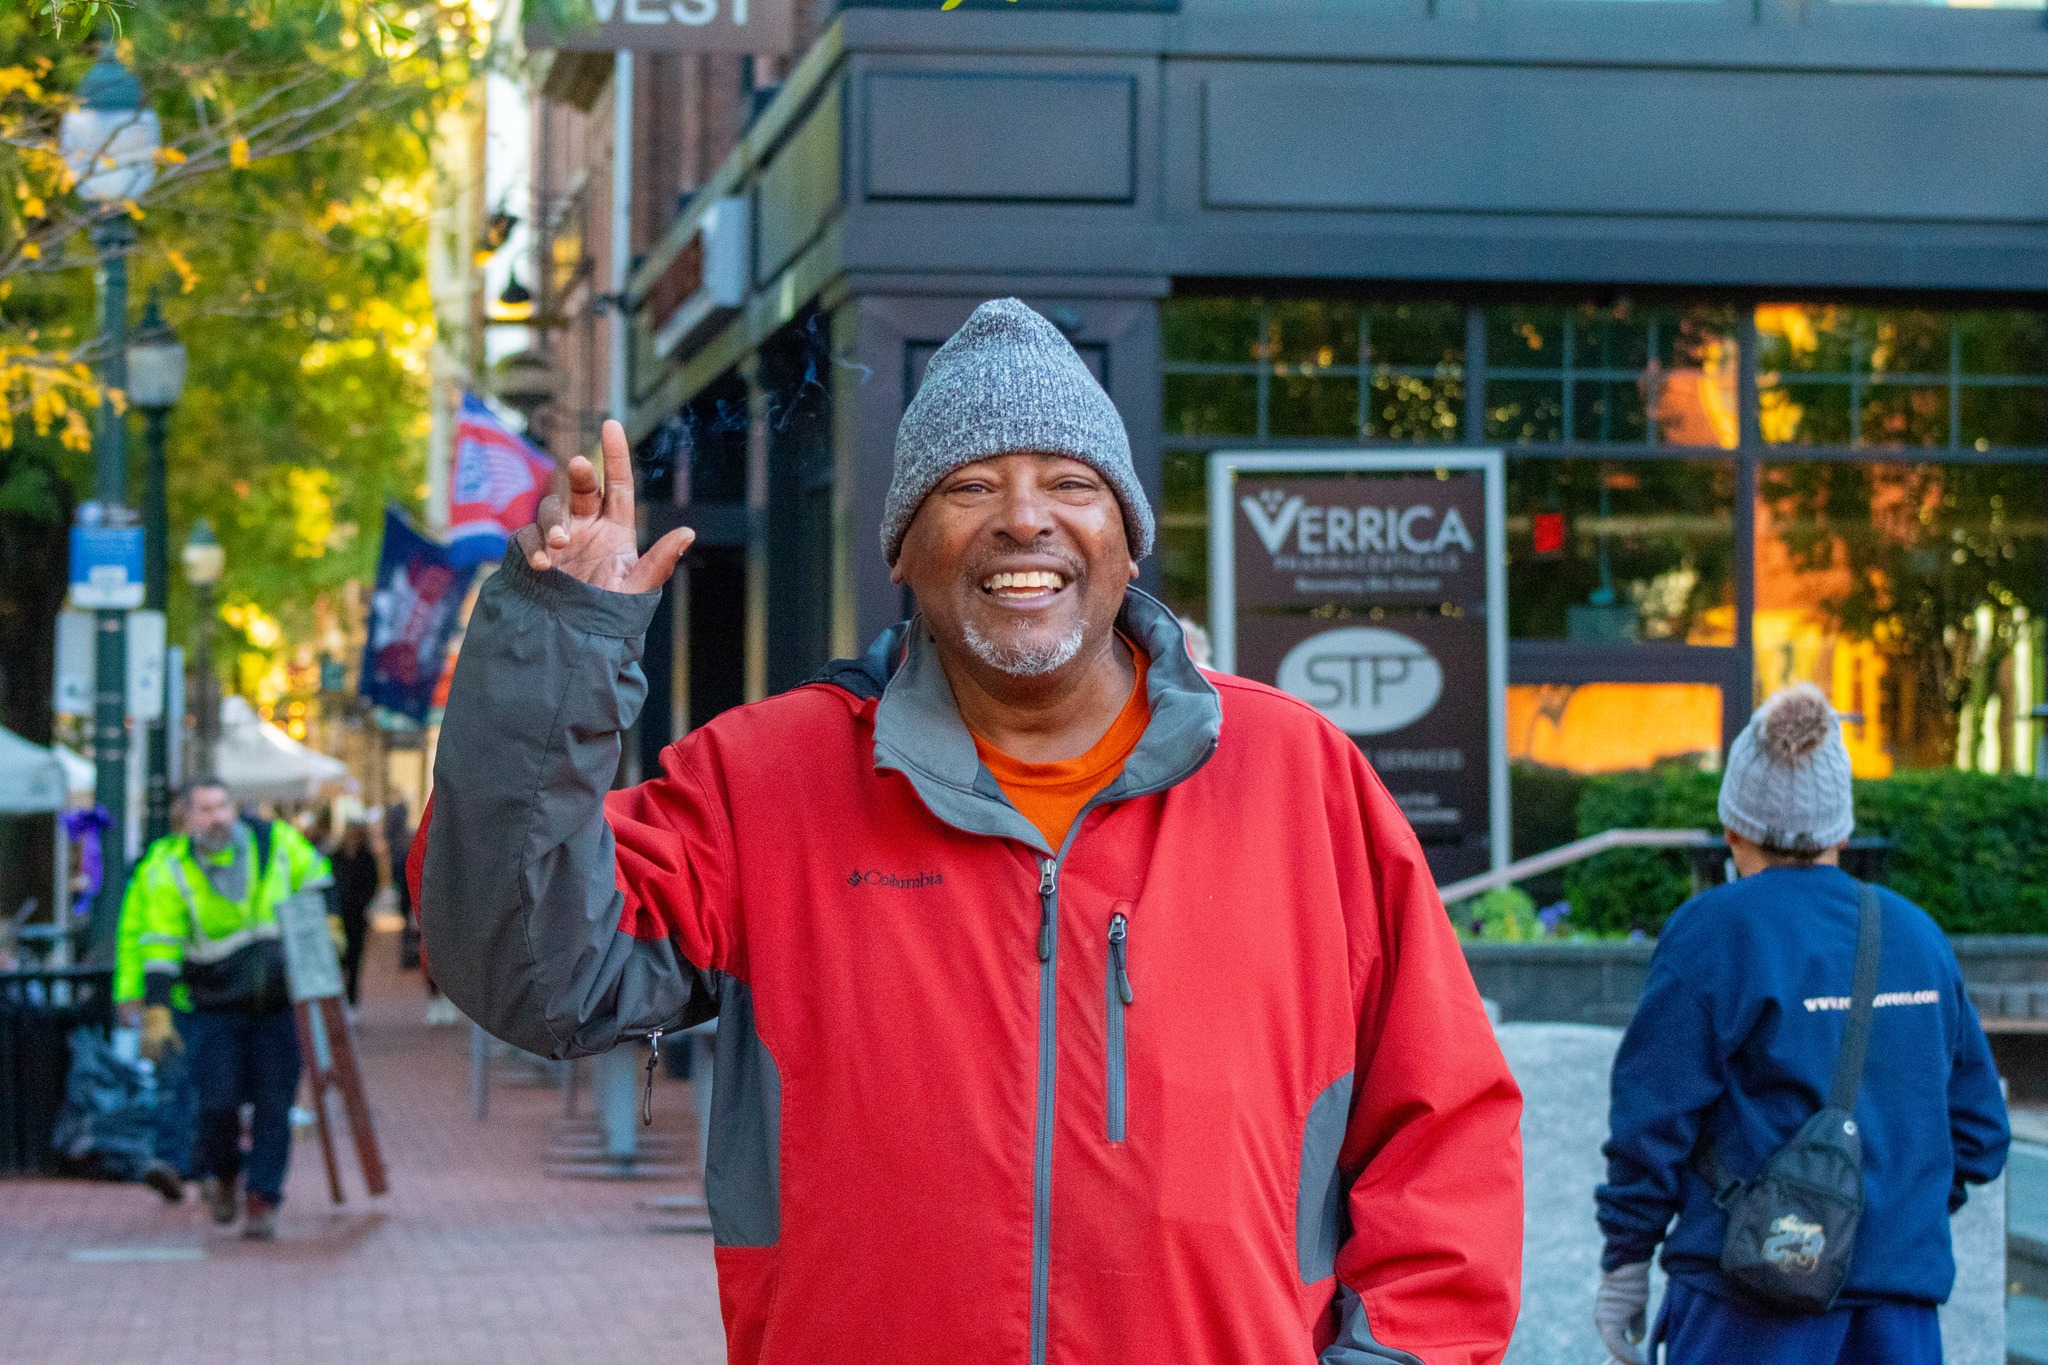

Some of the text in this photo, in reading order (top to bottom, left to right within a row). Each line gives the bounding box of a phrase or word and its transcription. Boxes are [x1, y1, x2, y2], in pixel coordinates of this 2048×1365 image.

[1240, 492, 1475, 554] VERRICA
[1305, 652, 1434, 710] STP
[863, 869, 944, 890] Columbia
